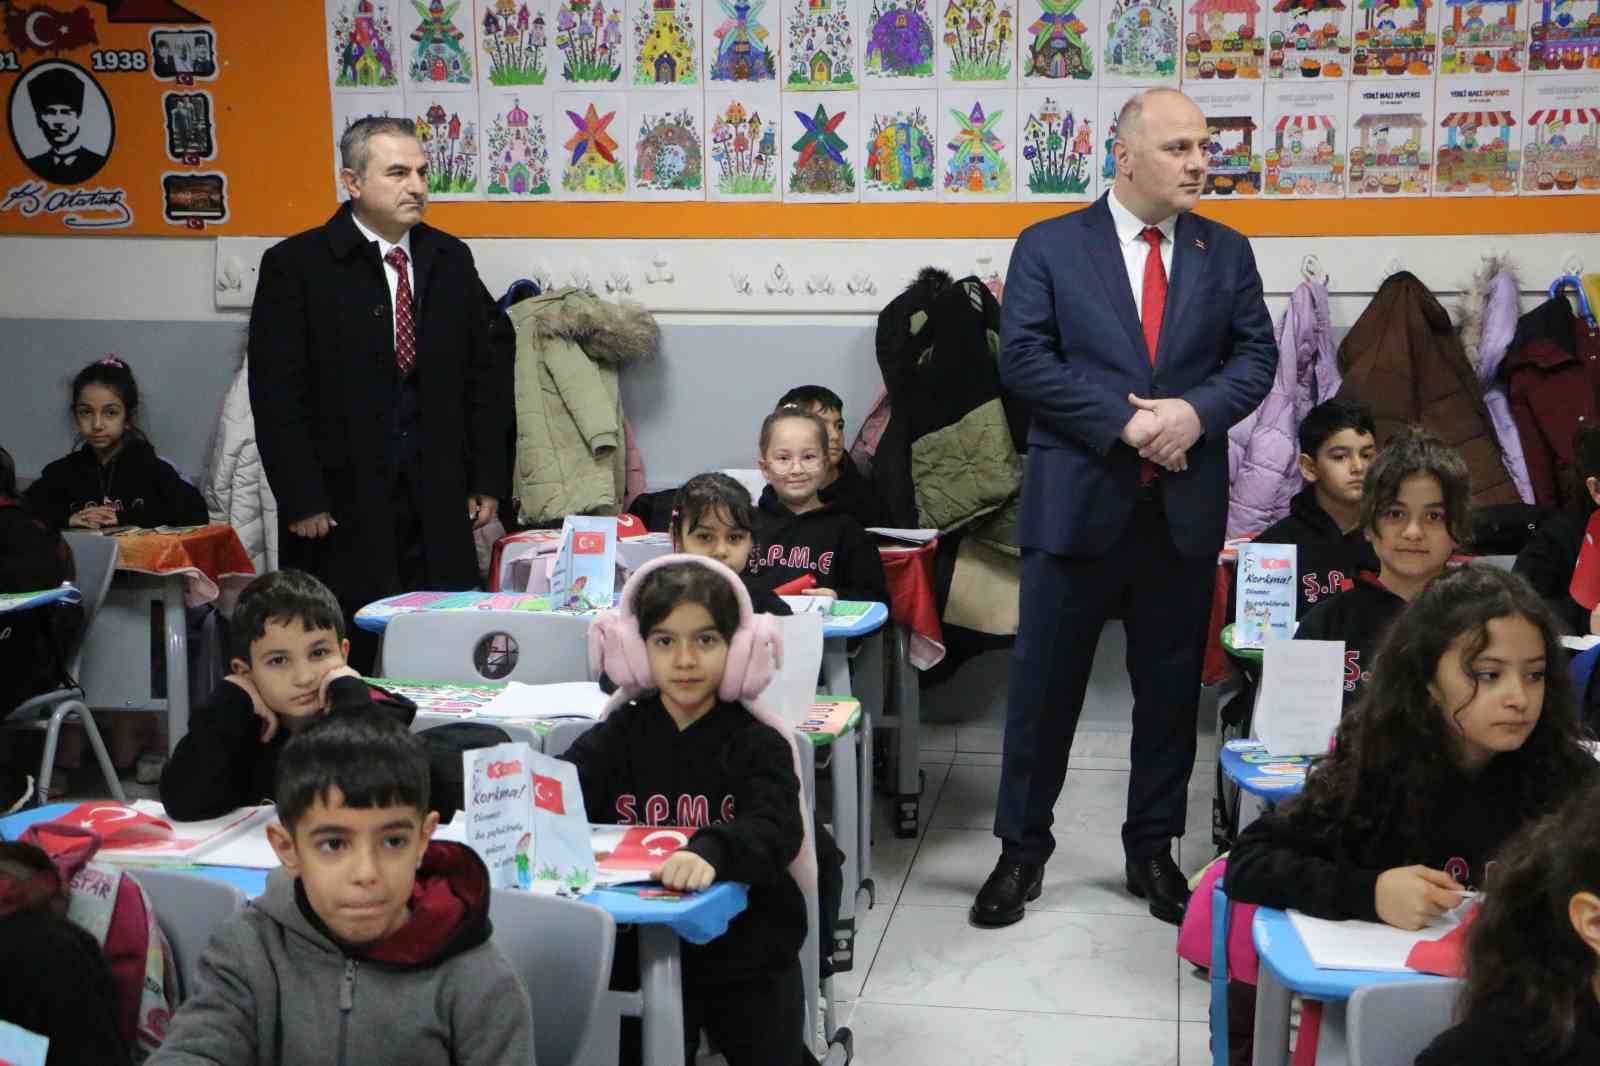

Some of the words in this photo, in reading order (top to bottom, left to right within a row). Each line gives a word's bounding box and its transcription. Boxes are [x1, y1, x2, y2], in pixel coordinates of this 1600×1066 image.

[92, 51, 147, 70] 1938
[1245, 574, 1292, 584] Korkma!
[472, 784, 526, 805] Korkma!
